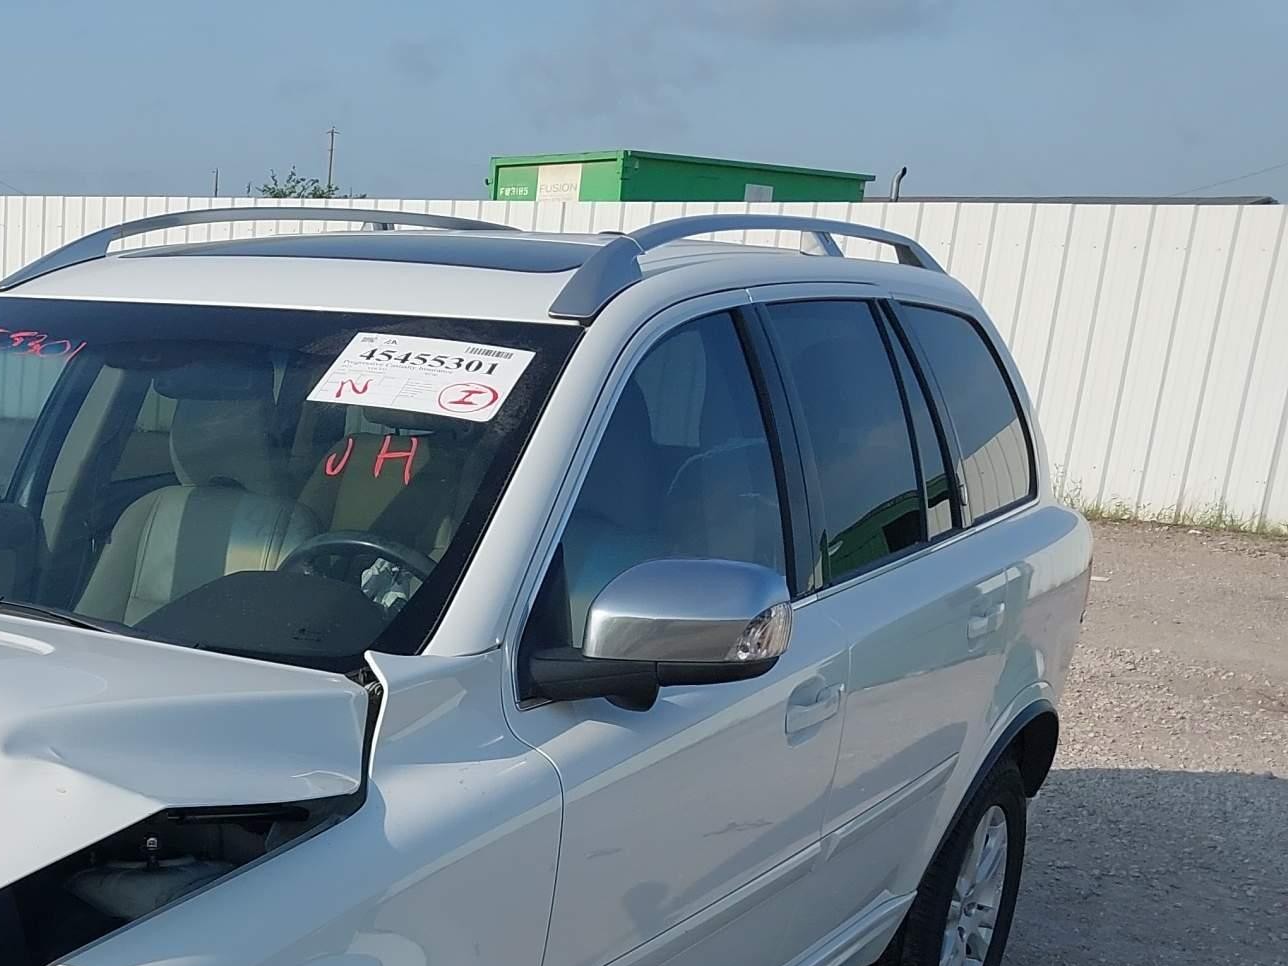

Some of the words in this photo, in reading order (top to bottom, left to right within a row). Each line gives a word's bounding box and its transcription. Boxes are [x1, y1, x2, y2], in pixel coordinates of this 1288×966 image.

[540, 183, 577, 193] FUSION
[359, 347, 499, 376] 45455301
[374, 434, 419, 486] H
